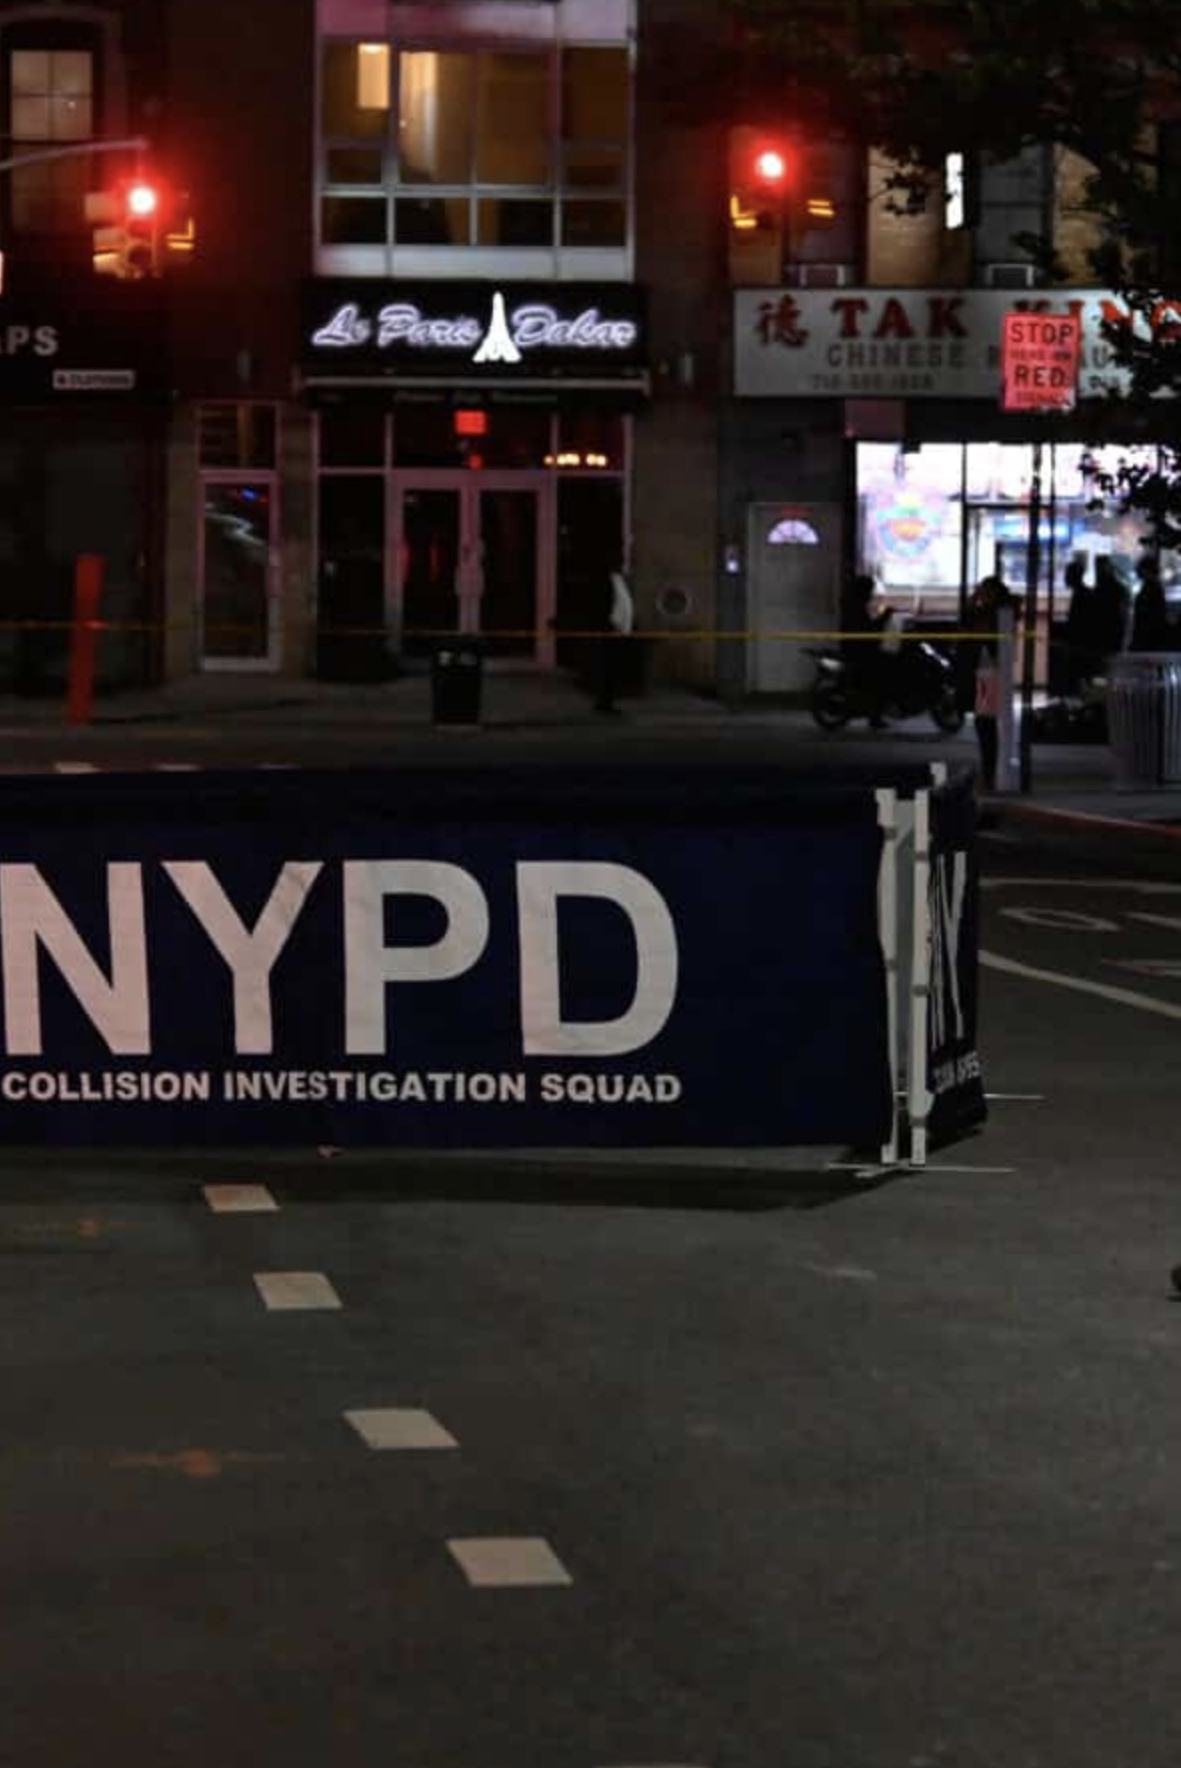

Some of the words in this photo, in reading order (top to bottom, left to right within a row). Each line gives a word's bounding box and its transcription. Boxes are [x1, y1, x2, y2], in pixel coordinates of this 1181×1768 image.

[311, 302, 371, 347] Le
[377, 303, 482, 347] Paris
[512, 305, 637, 348] Dakar
[830, 298, 967, 338] TAK
[1010, 322, 1074, 345] STOP
[827, 344, 966, 369] CHINESE
[1014, 364, 1067, 389] RED
[1, 1070, 210, 1103] COLLISION
[224, 1071, 522, 1103] INVESTIGATION
[538, 1074, 684, 1105] SQUAD
